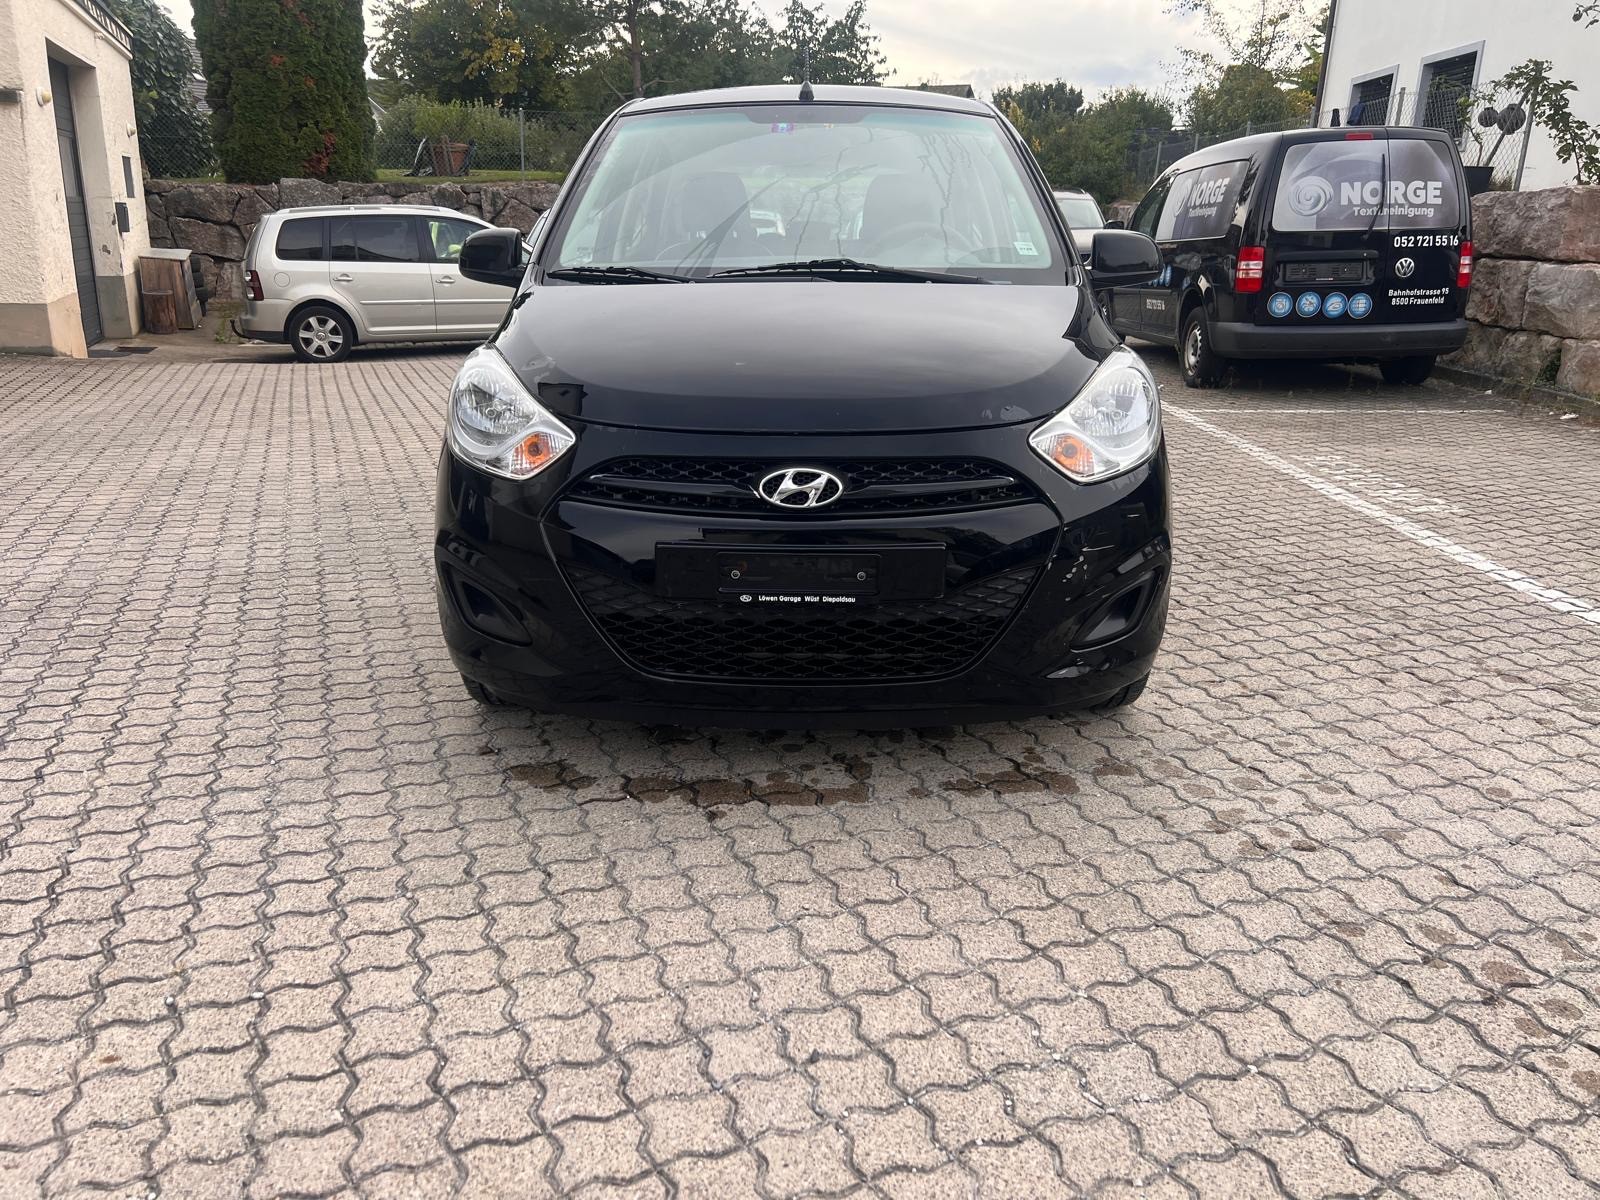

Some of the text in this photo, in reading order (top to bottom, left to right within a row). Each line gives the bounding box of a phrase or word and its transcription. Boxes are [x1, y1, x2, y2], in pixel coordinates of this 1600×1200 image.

[1187, 177, 1230, 207] NORGE
[1340, 180, 1442, 205] NORGE
[1393, 235, 1459, 247] 052 721 55 16
[1388, 289, 1441, 297] Bahnhofstrasse
[1391, 296, 1445, 305] 8500 Frauenfeld
